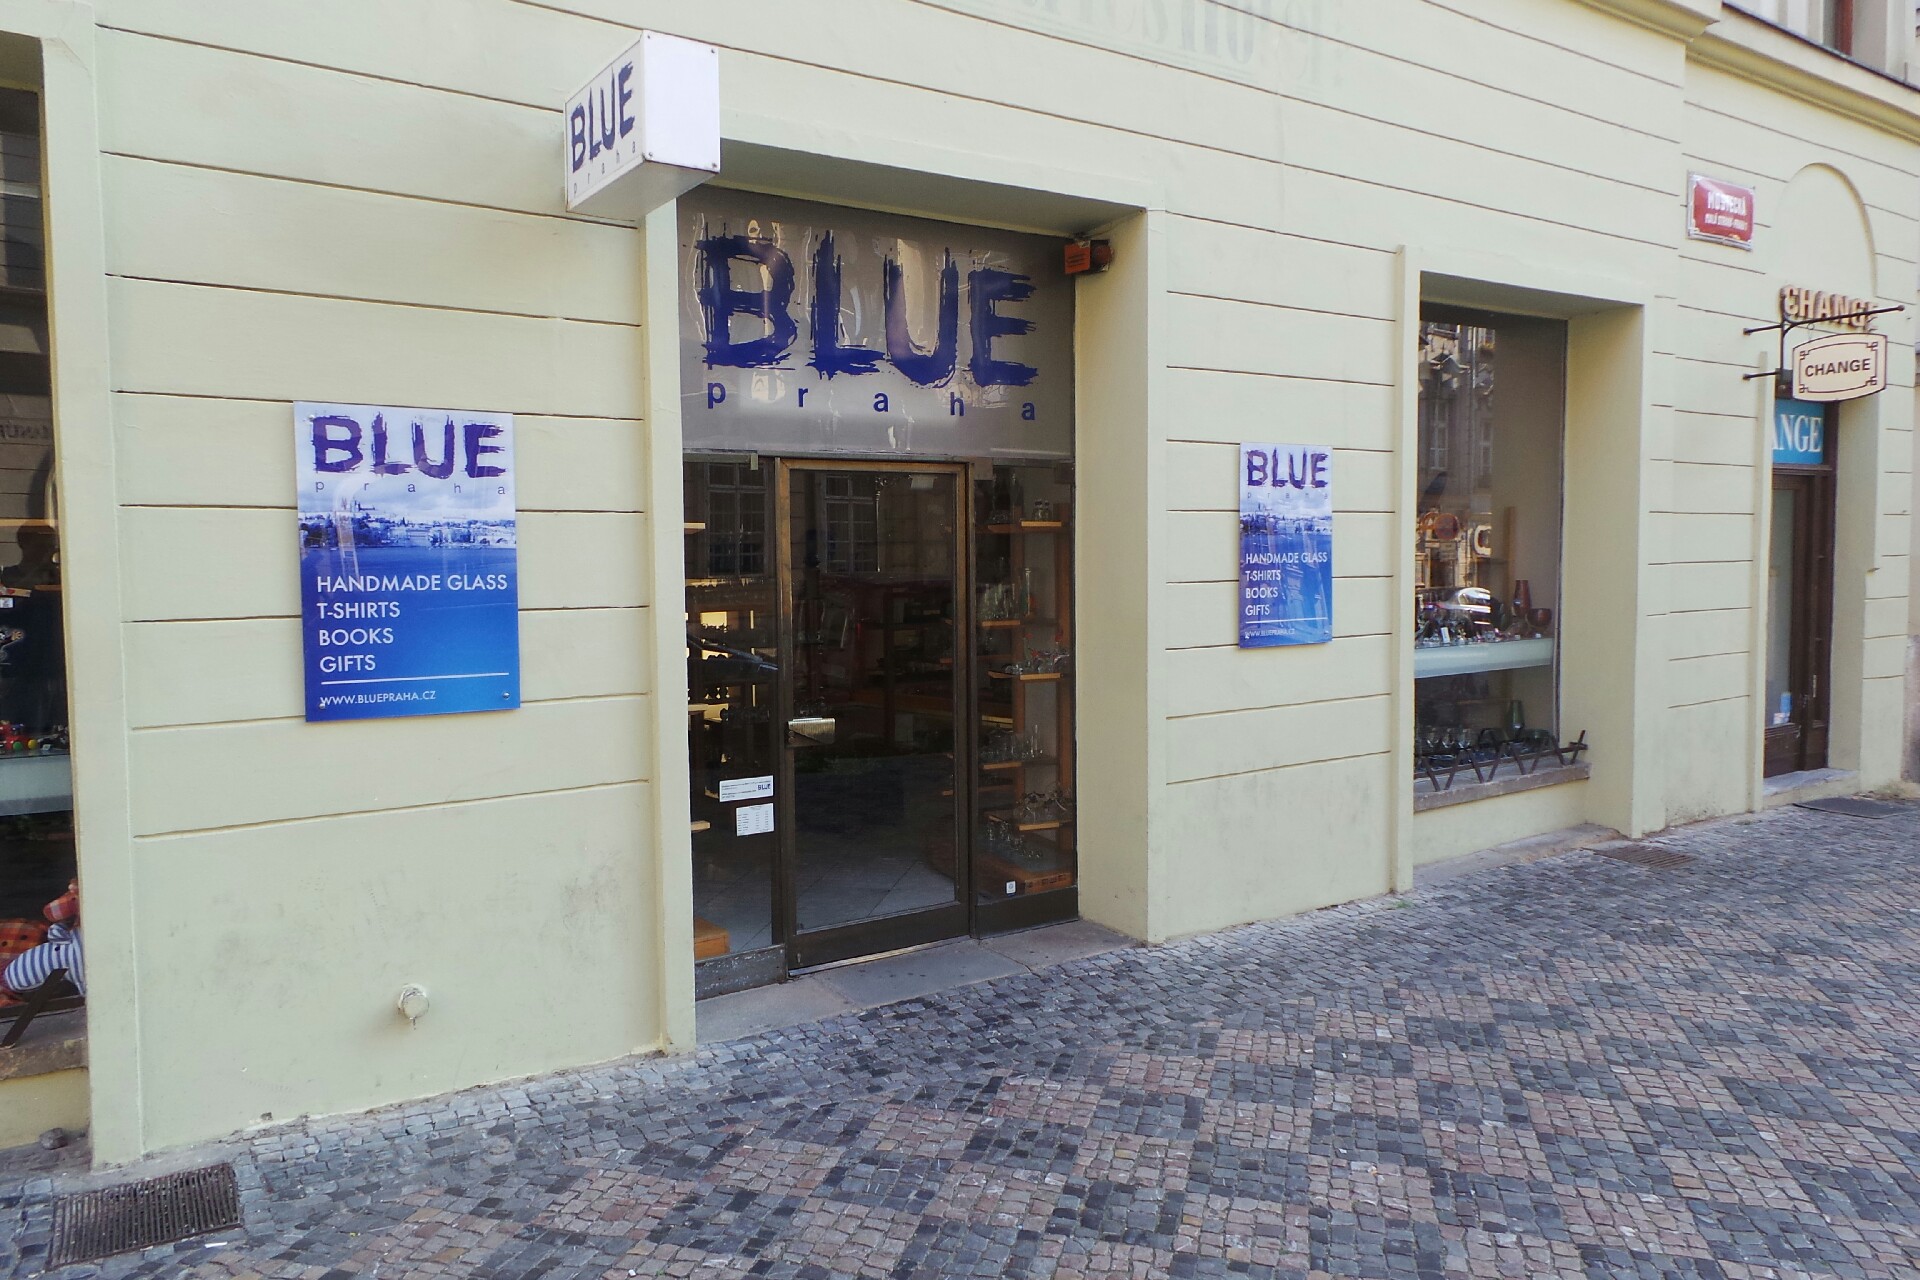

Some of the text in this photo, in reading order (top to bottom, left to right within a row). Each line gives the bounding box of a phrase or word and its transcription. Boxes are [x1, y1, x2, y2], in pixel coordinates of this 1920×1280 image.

[571, 61, 635, 173] BLUE
[573, 141, 636, 194] praha
[696, 224, 1039, 389] BLUE
[1783, 285, 1878, 332] CHANGE
[1804, 358, 1872, 377] CHANGE
[707, 381, 1036, 421] praha
[311, 411, 507, 479] BLUE
[1246, 448, 1329, 489] BLUE
[315, 481, 506, 496] praha
[1245, 551, 1328, 564] HANDMADE GLASS
[316, 574, 508, 593] HANDMADE GLASS
[1245, 569, 1281, 582] T-SHIRTS
[1245, 587, 1279, 599] BOOKS
[316, 601, 401, 619] T-SHIRTS
[1245, 604, 1270, 616] GIFTS
[319, 627, 394, 646] BOOKS
[319, 655, 377, 673] GIFTS
[320, 690, 436, 706] WWW.BLUEPRAHA.CZ
